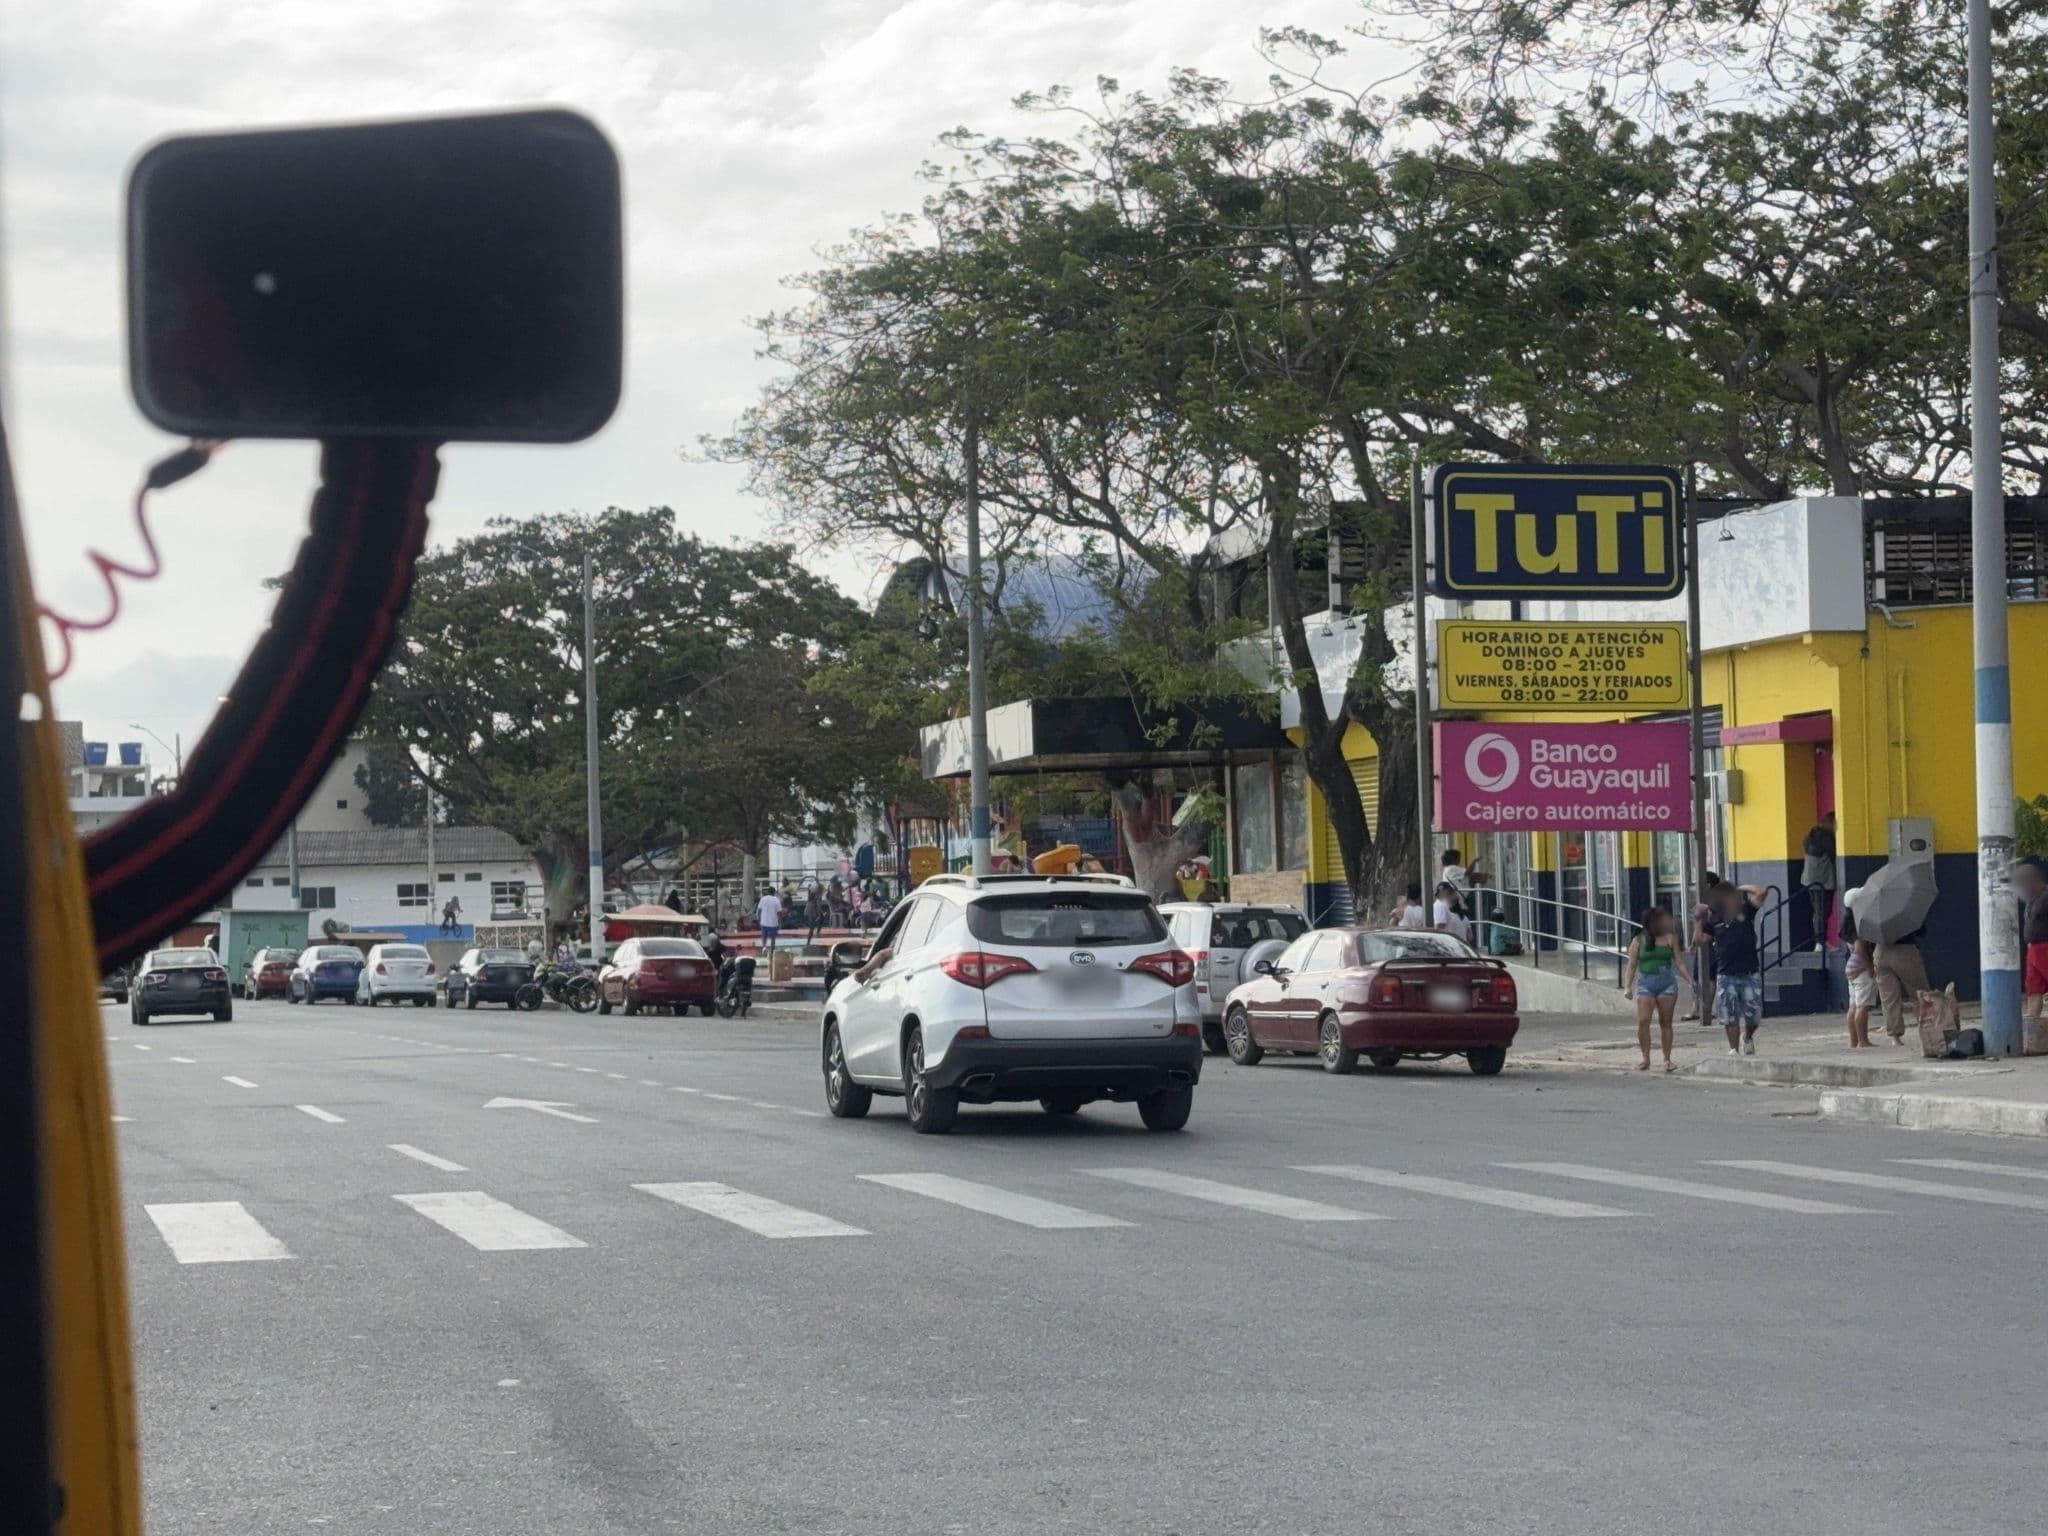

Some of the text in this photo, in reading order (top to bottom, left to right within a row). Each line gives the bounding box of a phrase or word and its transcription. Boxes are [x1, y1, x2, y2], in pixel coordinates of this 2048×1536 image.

[1455, 491, 1665, 575] TuTi
[1462, 629, 1664, 645] HORARIO DE ATENCIÓN
[1482, 646, 1646, 659] DOMINGO A JUEVES
[1502, 660, 1557, 671] 08:00
[1578, 660, 1626, 671] 21:00
[1521, 672, 1589, 687] SÁBADOS
[1594, 676, 1602, 688] Y
[1605, 675, 1673, 688] FERIADOS
[1501, 689, 1555, 702] 08:00
[1577, 689, 1629, 702] 22:00
[1530, 739, 1617, 764] Banco
[1529, 763, 1670, 794] Guayaquil
[1465, 800, 1671, 825] Cajero automático
